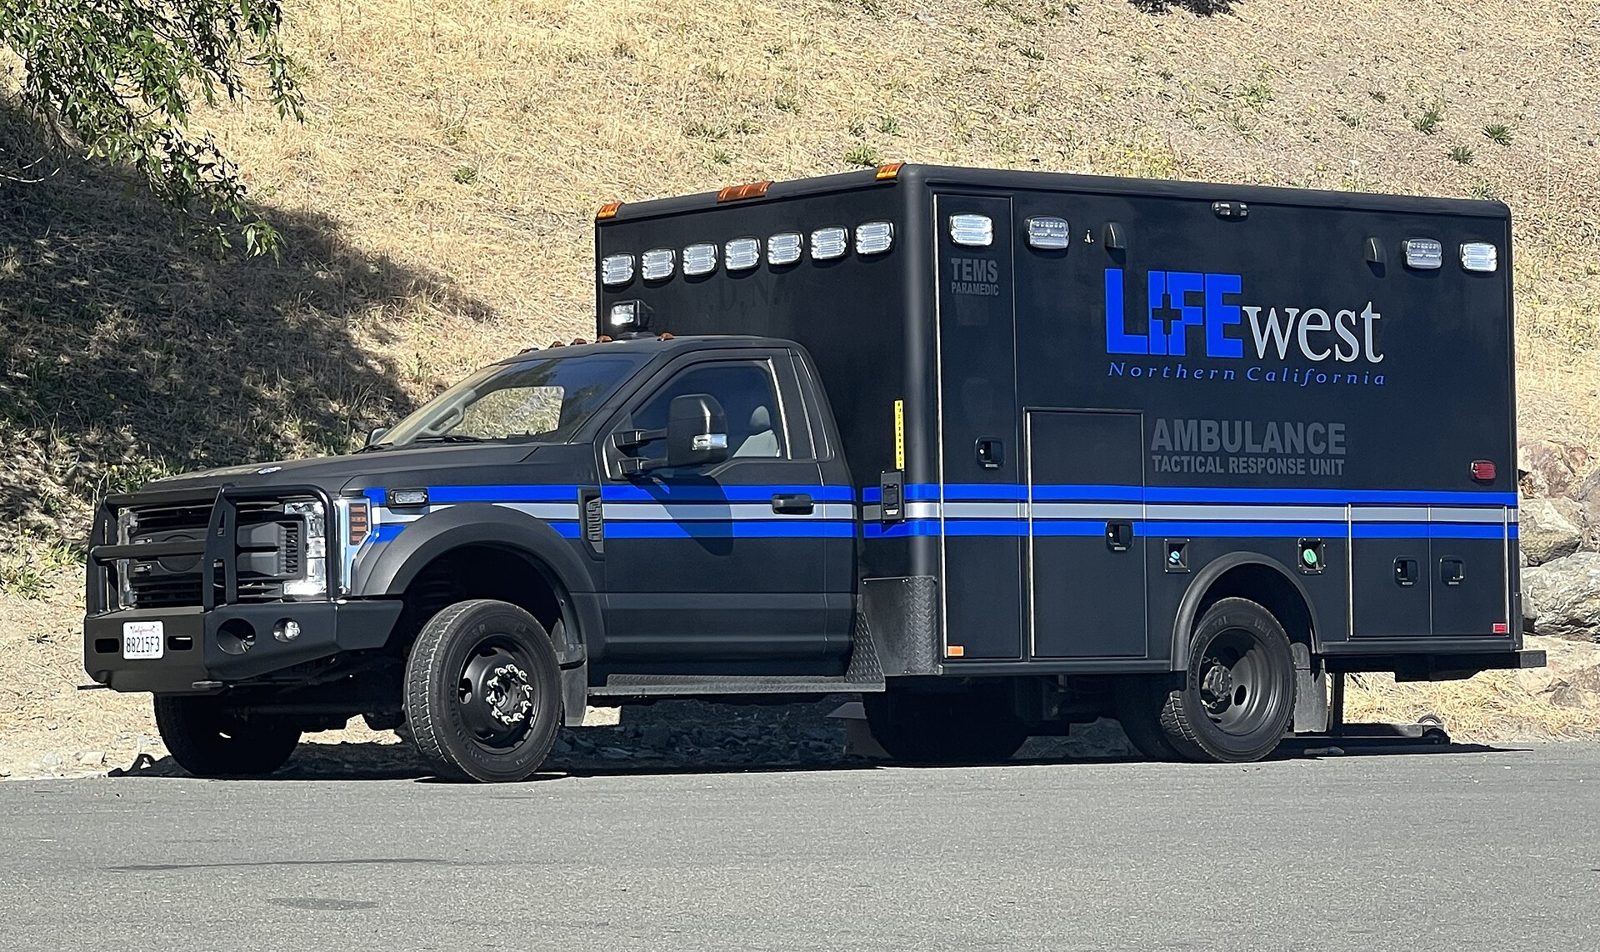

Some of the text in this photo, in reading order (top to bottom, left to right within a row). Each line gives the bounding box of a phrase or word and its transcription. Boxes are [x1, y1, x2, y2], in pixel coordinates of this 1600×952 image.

[951, 257, 998, 283] TEMS
[951, 281, 999, 296] PARAMEDIC
[1108, 362, 1386, 387] Northern California
[1151, 418, 1346, 455] AMBULANCE
[1152, 455, 1345, 475] TACTICAL RESPONSE UNIT
[126, 636, 160, 653] 88215F3
